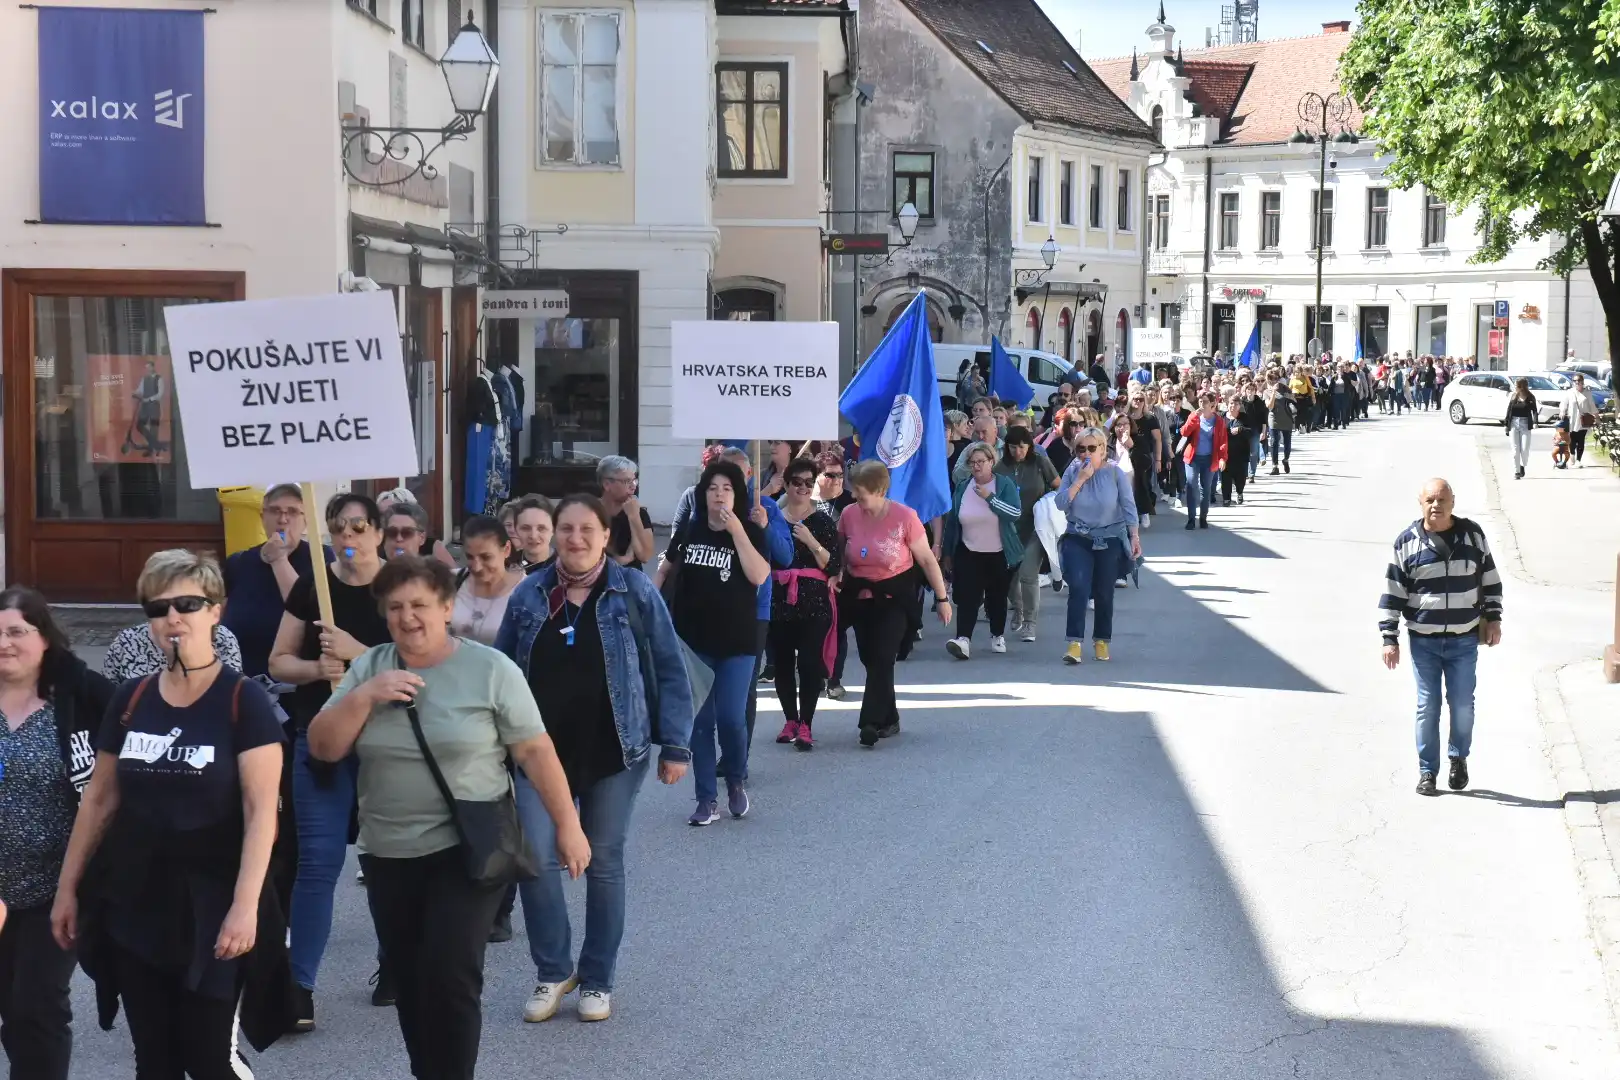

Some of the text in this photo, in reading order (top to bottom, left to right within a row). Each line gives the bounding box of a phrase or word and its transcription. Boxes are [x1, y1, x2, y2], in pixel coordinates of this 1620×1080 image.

[51, 96, 138, 120] xalax
[50, 132, 63, 140] ERP
[88, 133, 103, 141] than
[109, 134, 136, 142] software
[482, 297, 569, 310] sandra i toni
[1498, 302, 1505, 314] P
[188, 337, 383, 373] POKUŠAJTE VI
[682, 364, 828, 379] HRVATSKA TREBA
[241, 378, 339, 407] ŽIVJETI
[717, 383, 792, 397] VARTEKS
[221, 413, 371, 448] BEZ PLAĆE
[684, 548, 732, 569] VARTEKS
